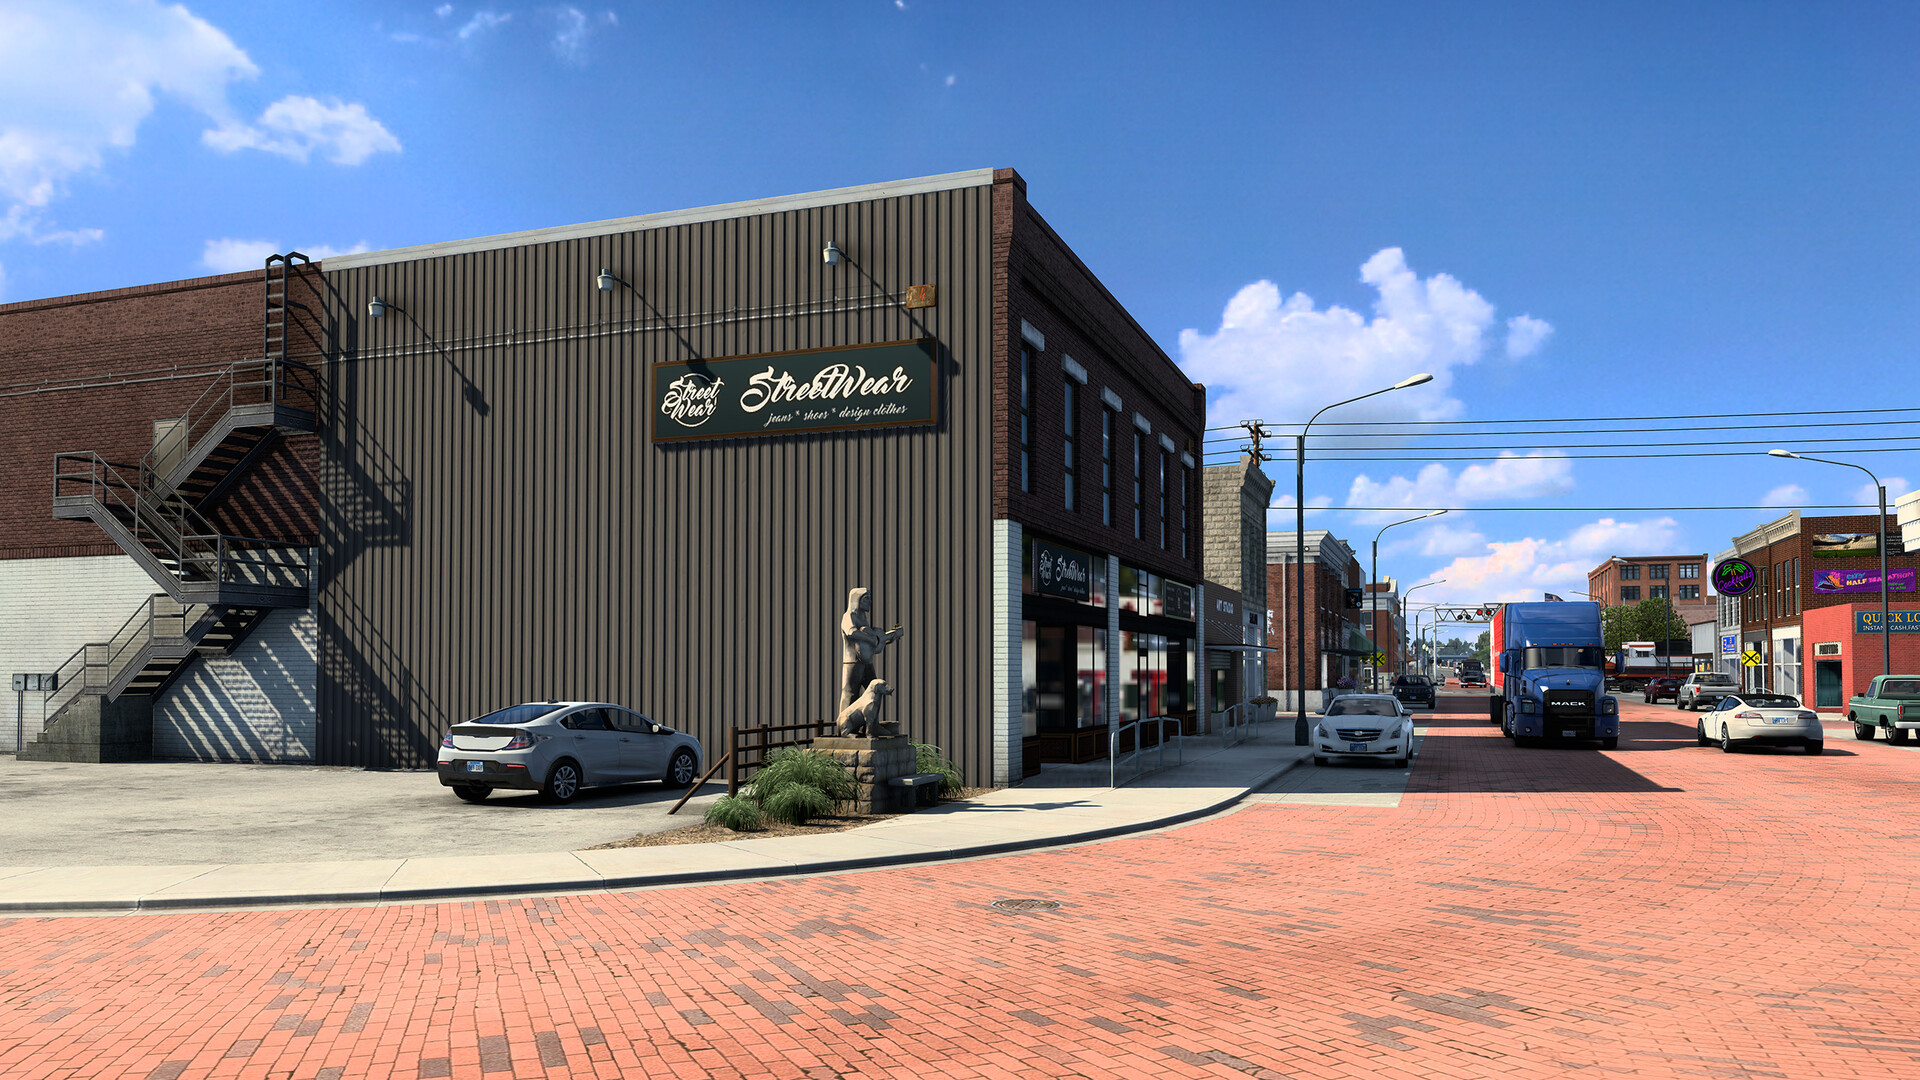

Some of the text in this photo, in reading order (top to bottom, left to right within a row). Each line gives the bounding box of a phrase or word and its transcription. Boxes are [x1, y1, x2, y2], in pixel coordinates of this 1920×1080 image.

[664, 376, 725, 408] Street
[740, 363, 913, 413] StreetWear
[661, 396, 717, 420] Wear
[763, 403, 908, 428] jeans shoes design clothes
[1717, 569, 1752, 592] Cocktails
[1846, 571, 1914, 586] HALF MAATHON
[1863, 613, 1904, 625] QUCK
